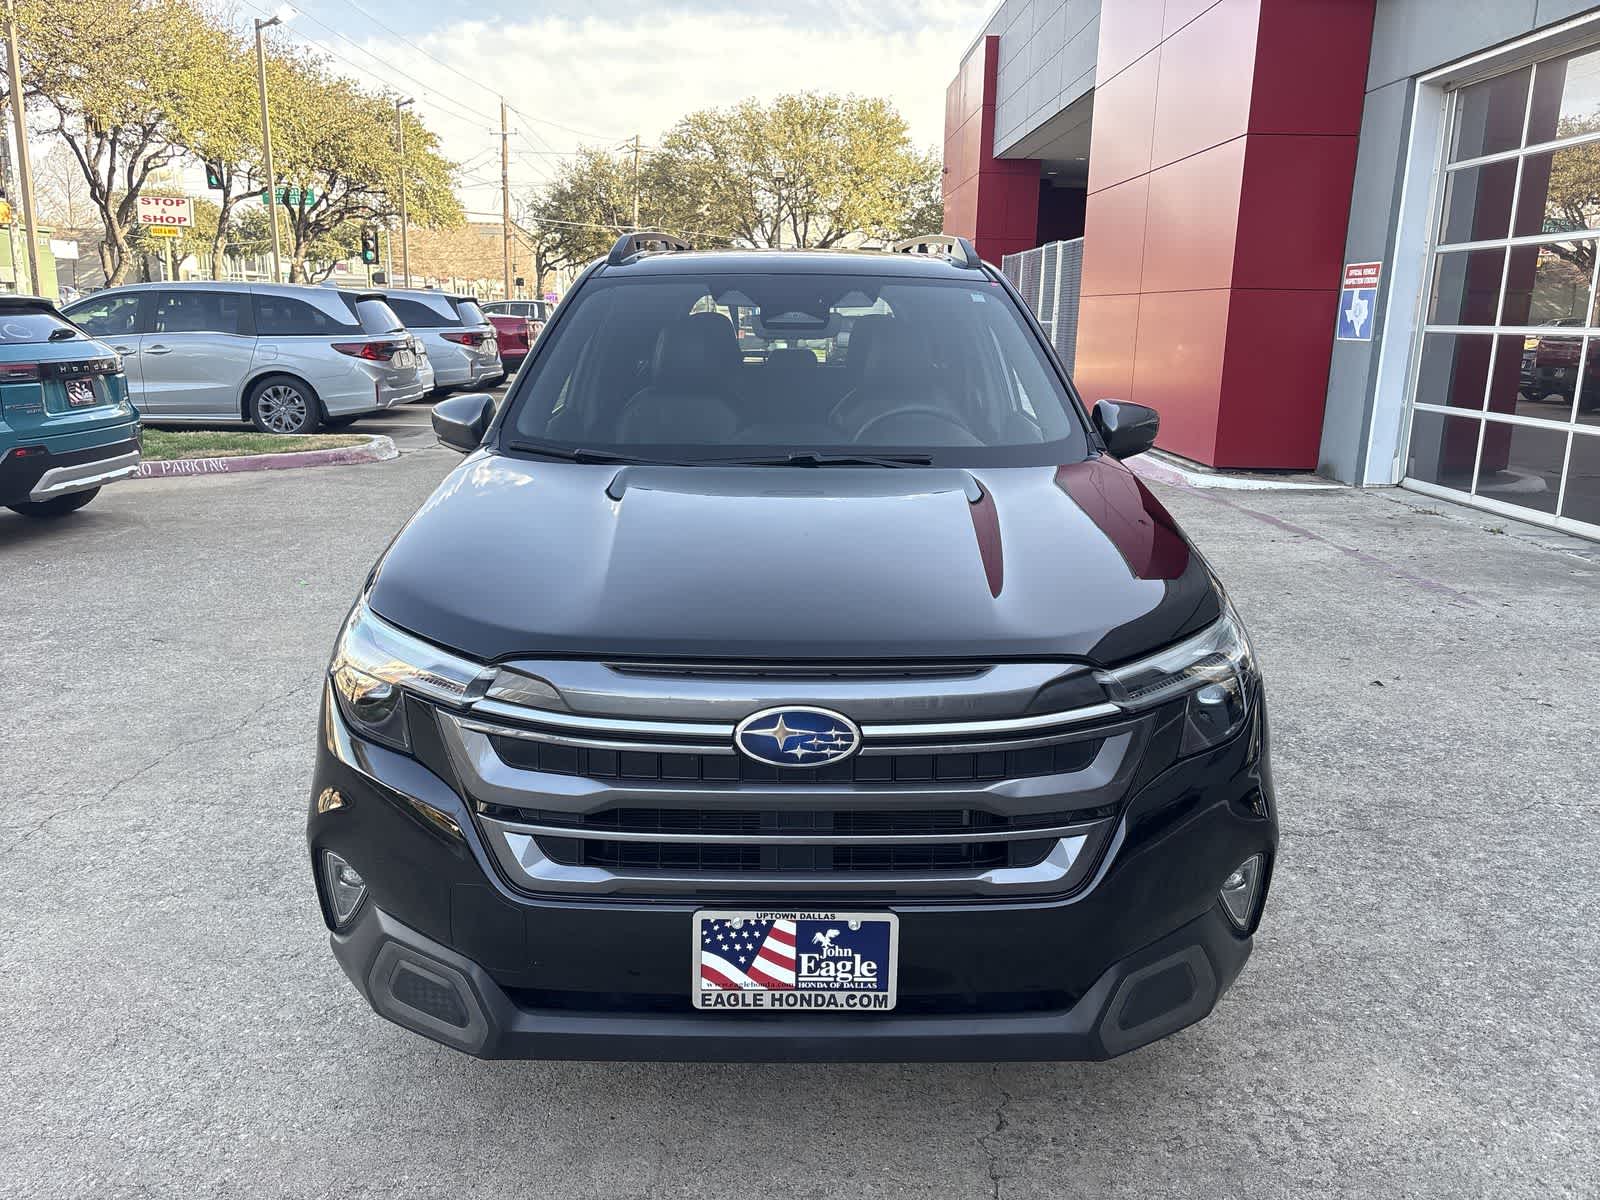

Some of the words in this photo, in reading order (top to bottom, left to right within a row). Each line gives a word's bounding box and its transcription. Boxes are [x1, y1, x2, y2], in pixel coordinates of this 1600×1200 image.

[141, 198, 186, 206] STOP
[142, 215, 187, 224] SHOP
[161, 459, 229, 474] PARKING
[756, 912, 797, 920] UPTOWN
[799, 913, 836, 921] DALLAS
[798, 953, 878, 982] Eagle
[701, 992, 764, 1008] EAGLE
[770, 993, 889, 1009] HONDA.COM
